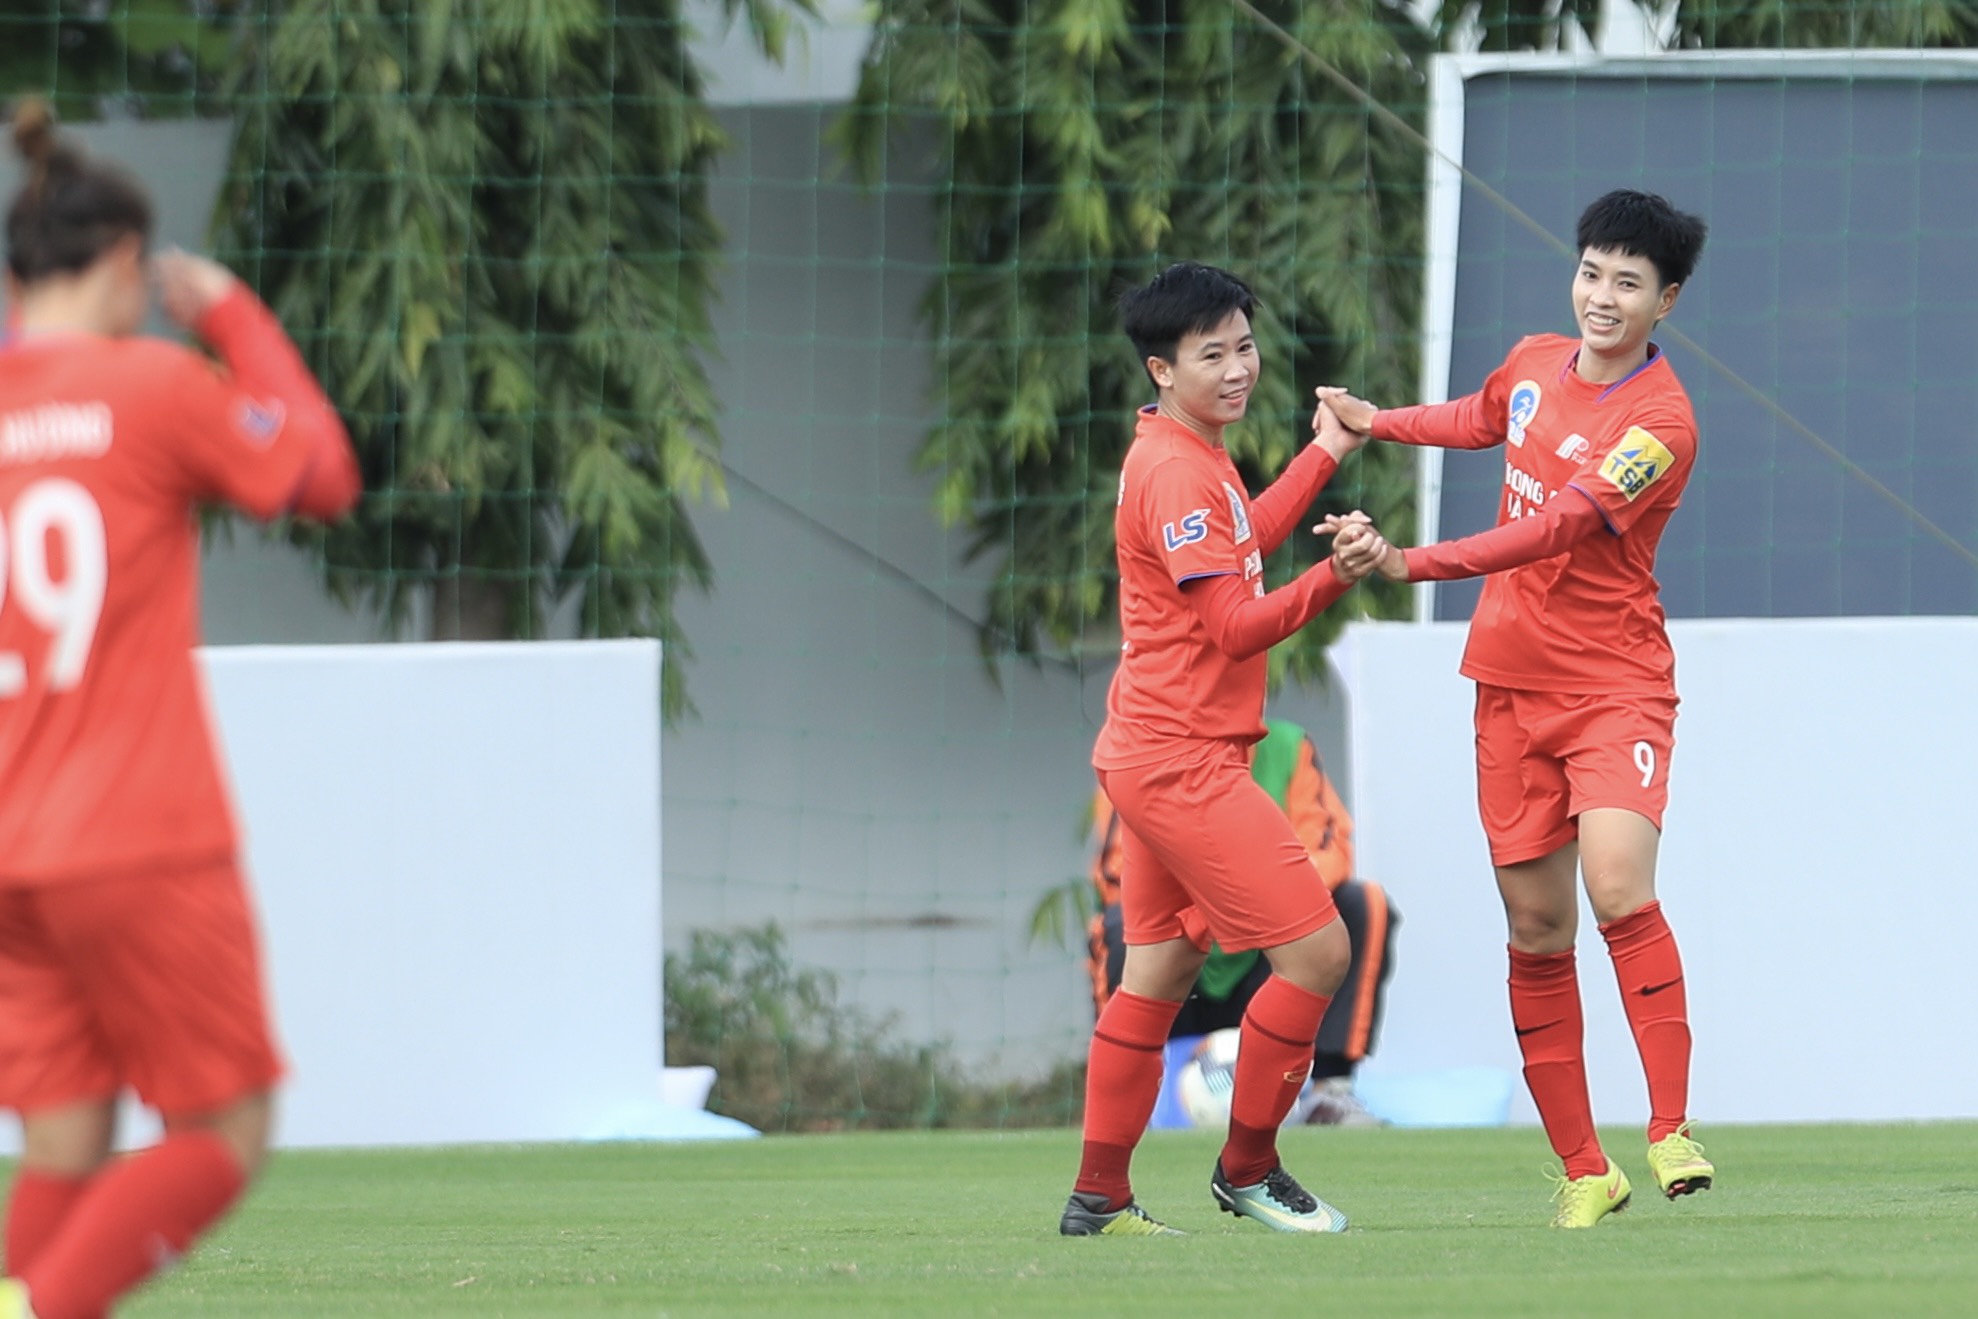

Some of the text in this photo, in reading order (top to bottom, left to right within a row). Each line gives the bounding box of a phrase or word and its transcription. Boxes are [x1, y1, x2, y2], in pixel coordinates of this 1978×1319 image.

[1610, 456, 1645, 494] TSB
[1163, 508, 1211, 552] LS
[0, 478, 107, 694] 9
[1633, 741, 1655, 788] 9
